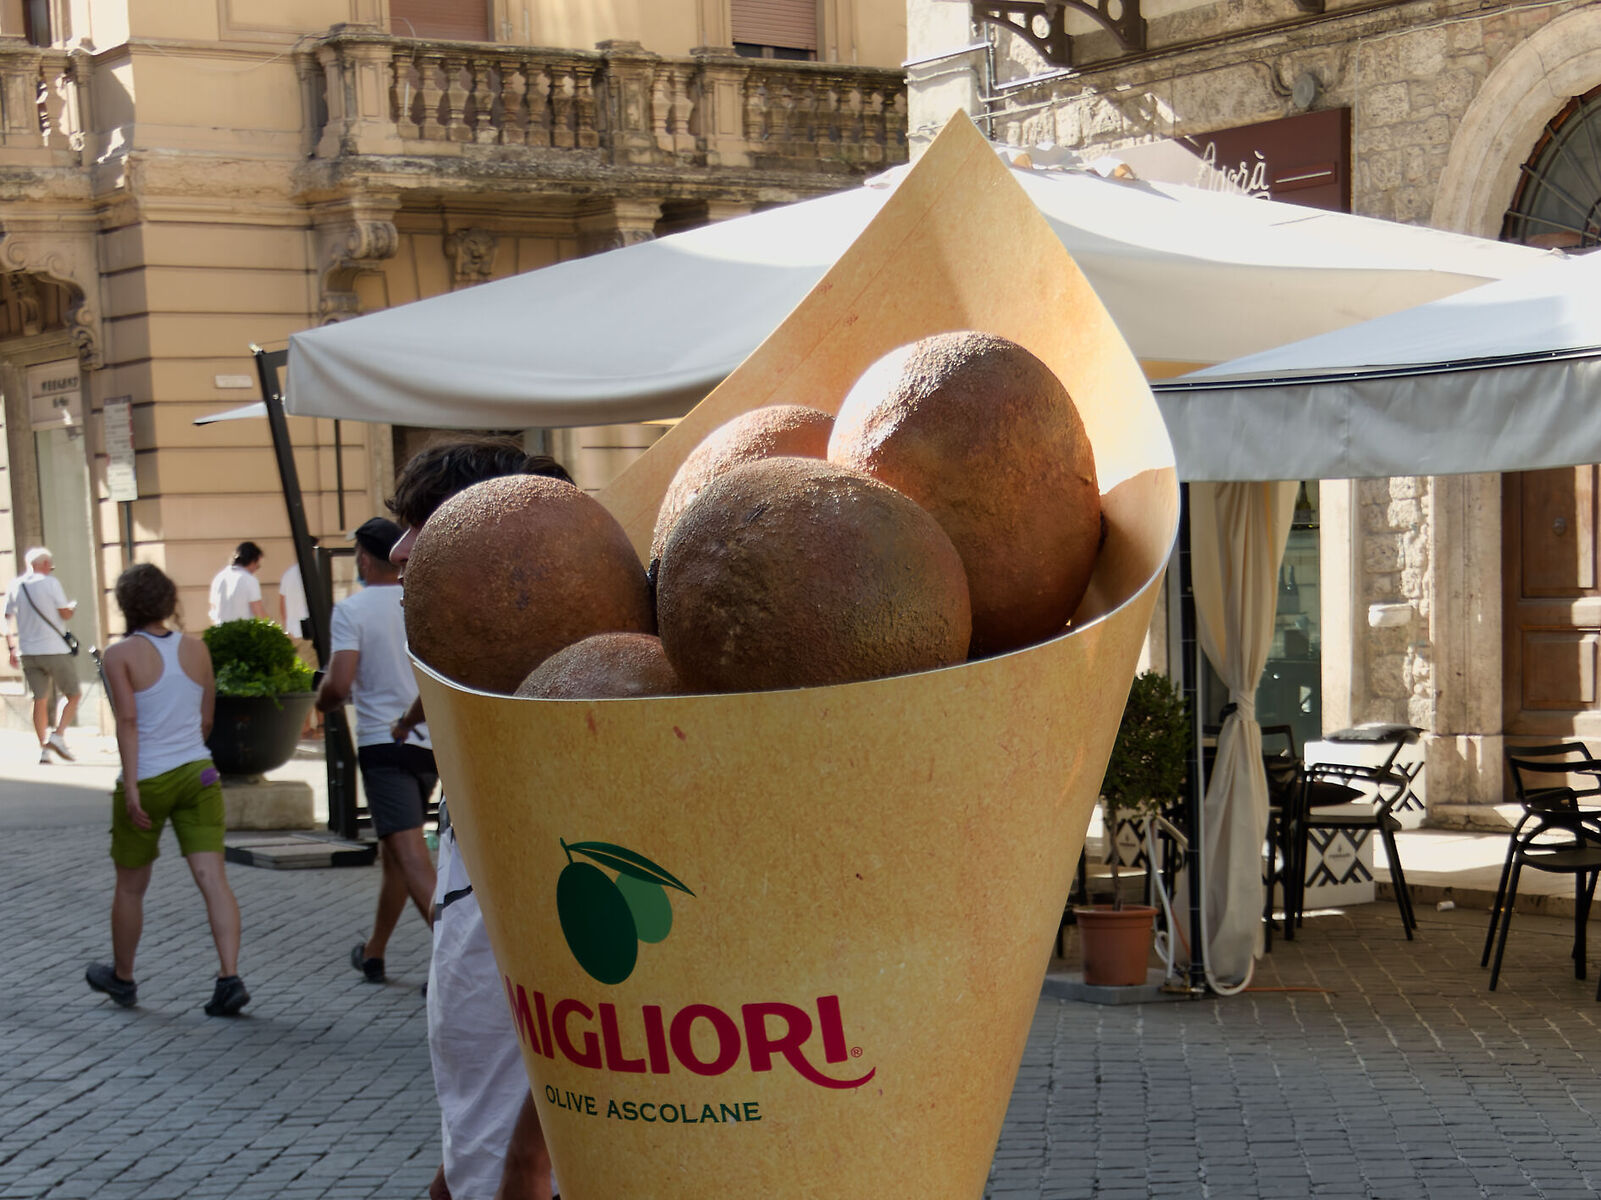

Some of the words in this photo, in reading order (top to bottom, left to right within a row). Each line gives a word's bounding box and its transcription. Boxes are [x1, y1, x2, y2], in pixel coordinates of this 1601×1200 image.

[505, 975, 877, 1089] MIGLIORI
[545, 1084, 598, 1116] OLIVE
[606, 1099, 763, 1124] ASCOLANE
